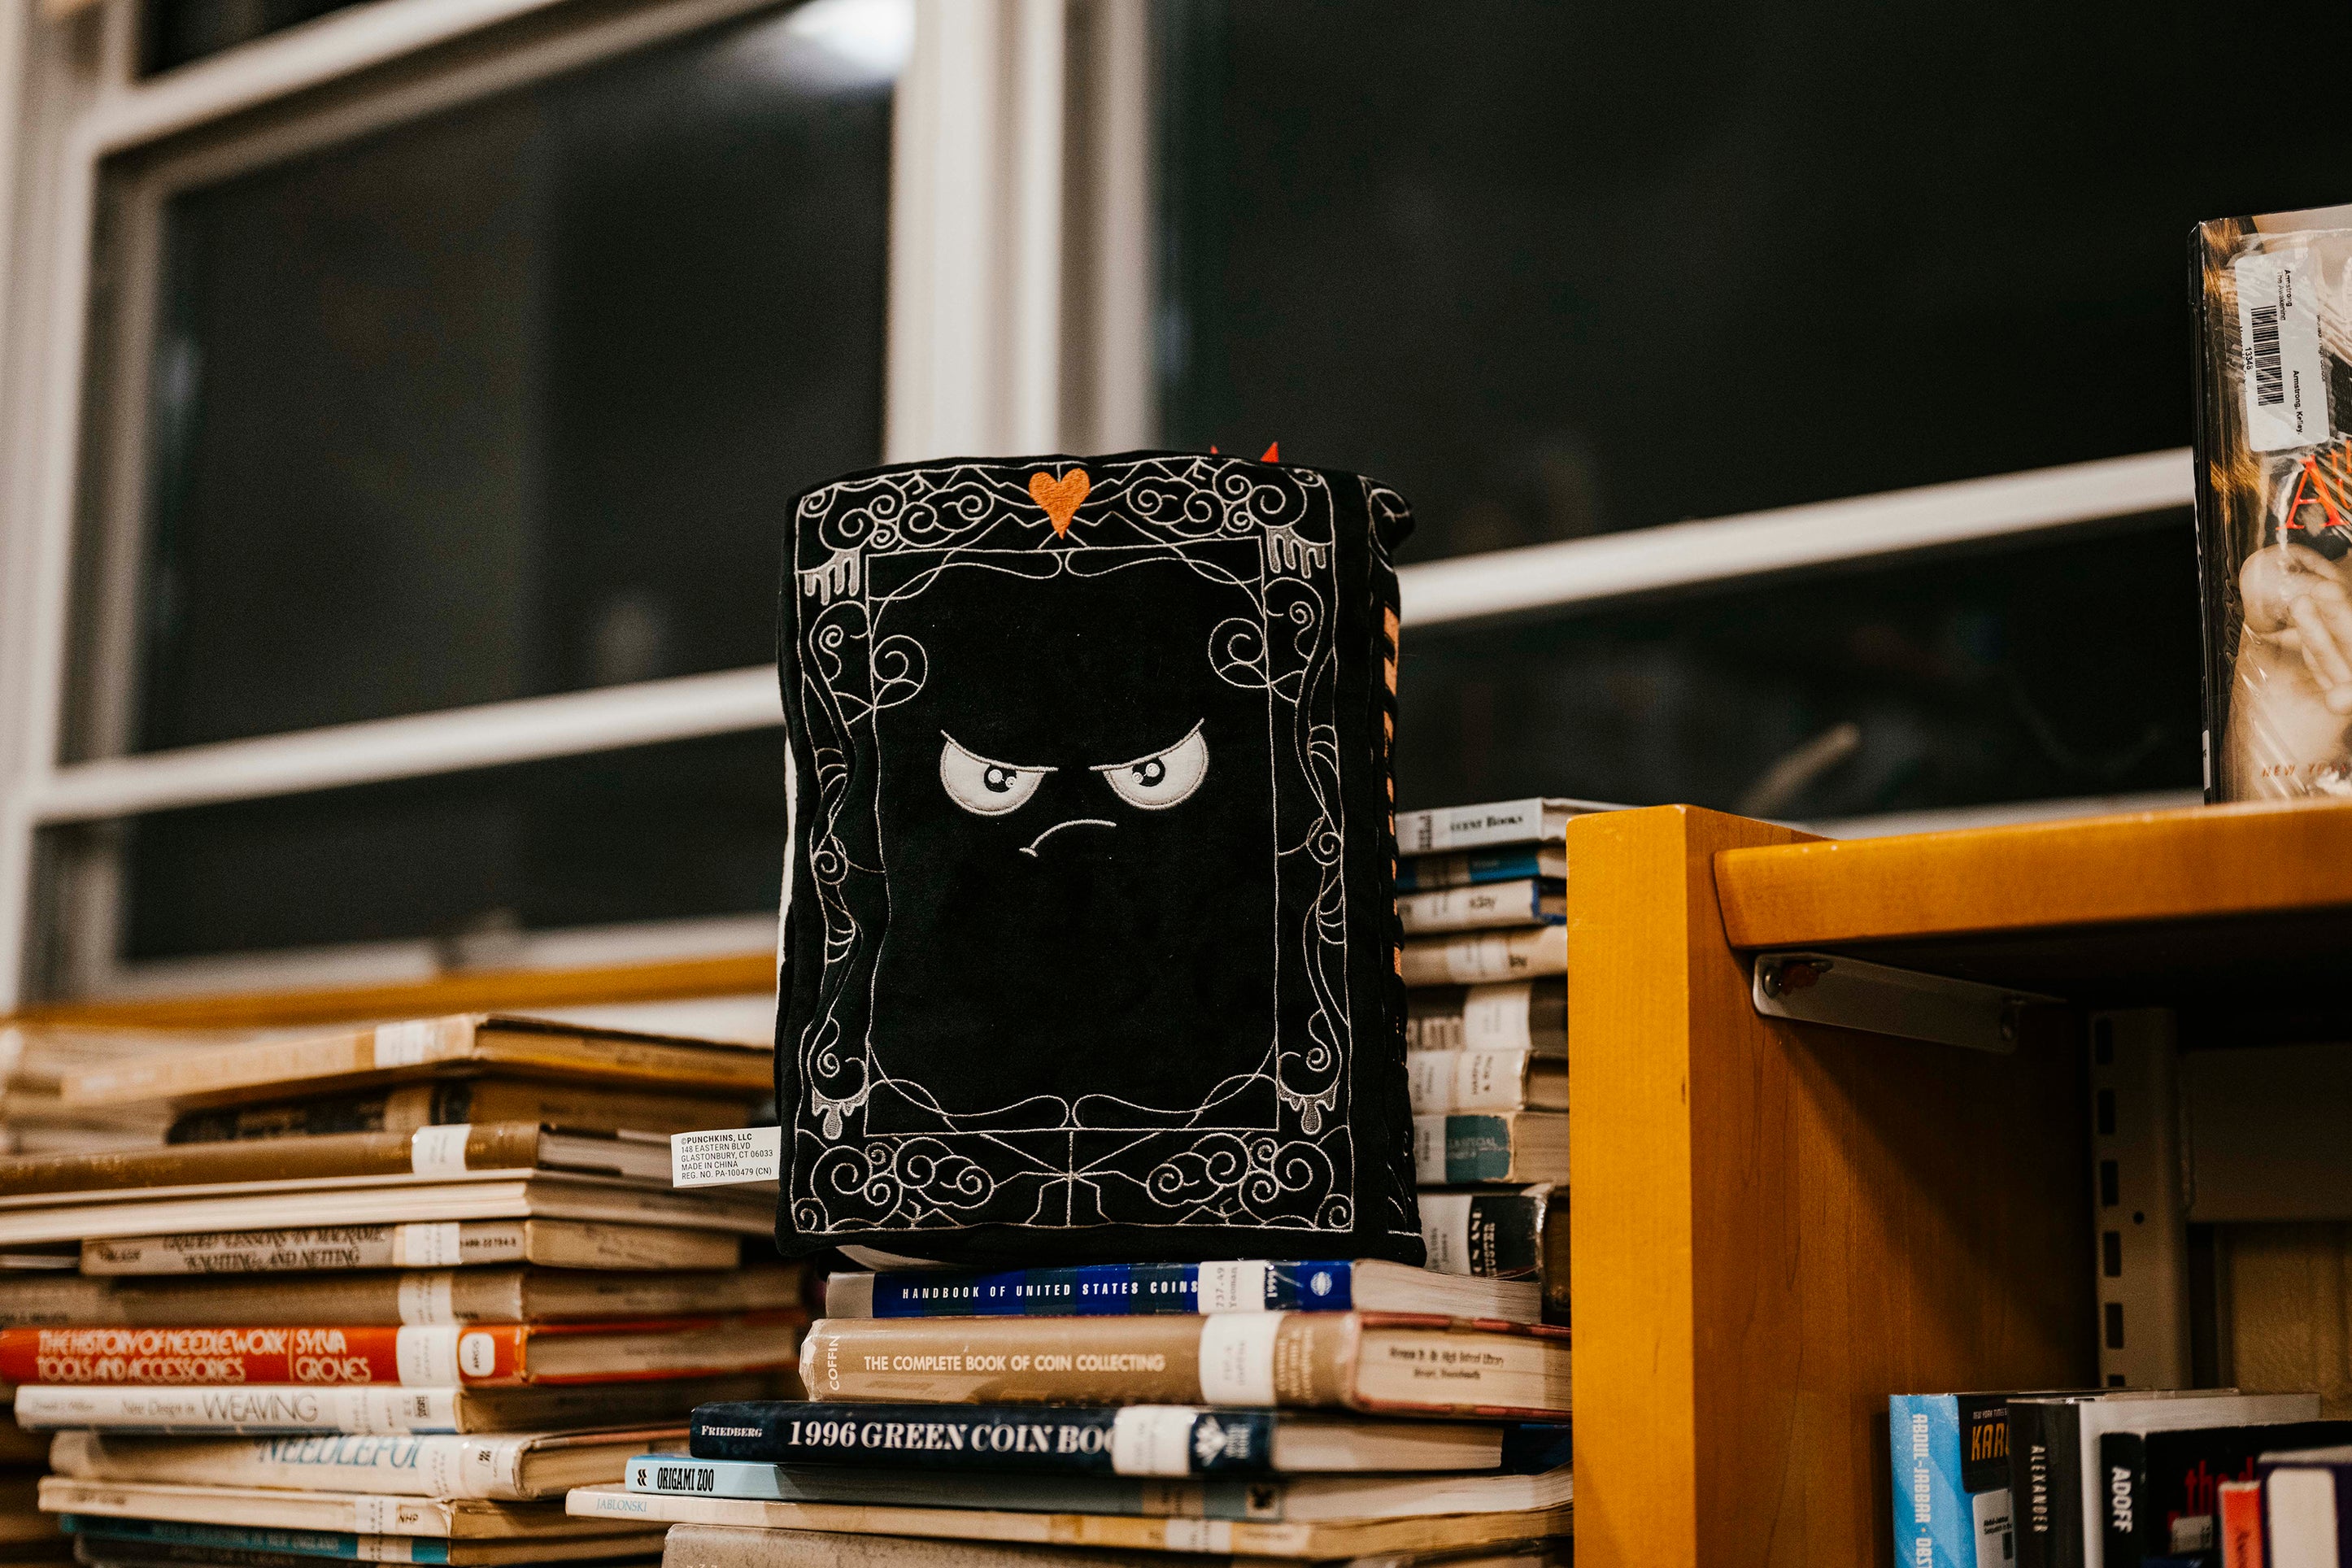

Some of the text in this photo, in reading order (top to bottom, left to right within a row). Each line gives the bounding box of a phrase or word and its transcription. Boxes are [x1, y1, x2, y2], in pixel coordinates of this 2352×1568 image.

[2245, 346, 2254, 370] 13348
[682, 1142, 751, 1153] 148 EASTERN BLVD
[738, 1133, 752, 1141] LLC
[682, 1152, 737, 1162] GLASTONBURY,
[750, 1149, 773, 1157] 06033
[682, 1162, 702, 1170] MADE
[714, 1161, 738, 1169] CHINA
[682, 1167, 772, 1179] REG. NO. PA-100479 (CN)
[902, 1280, 1198, 1300] HANDBOOK OF UNITED STATES COINS
[37, 1356, 93, 1383] TOOLS
[295, 1356, 372, 1383] GROVES
[827, 1335, 840, 1392] COFFIN
[864, 1353, 1166, 1372] THE COMPLETE BOOK OF COIN COLLECTING
[203, 1392, 318, 1422] WEAVING
[701, 1425, 763, 1438] FRIEDBERG
[787, 1420, 856, 1448] 1996
[860, 1422, 968, 1450] GREEN
[971, 1423, 1055, 1453] COIN
[1056, 1424, 1115, 1455] BO
[657, 1467, 714, 1492] ORIGAMI ZOO
[1912, 1413, 1933, 1568] ABDUL-JABBAR OBS
[2031, 1444, 2049, 1533] ALEXANDER
[596, 1498, 648, 1513] JABLONSKI
[2111, 1466, 2133, 1534] ADOFF
